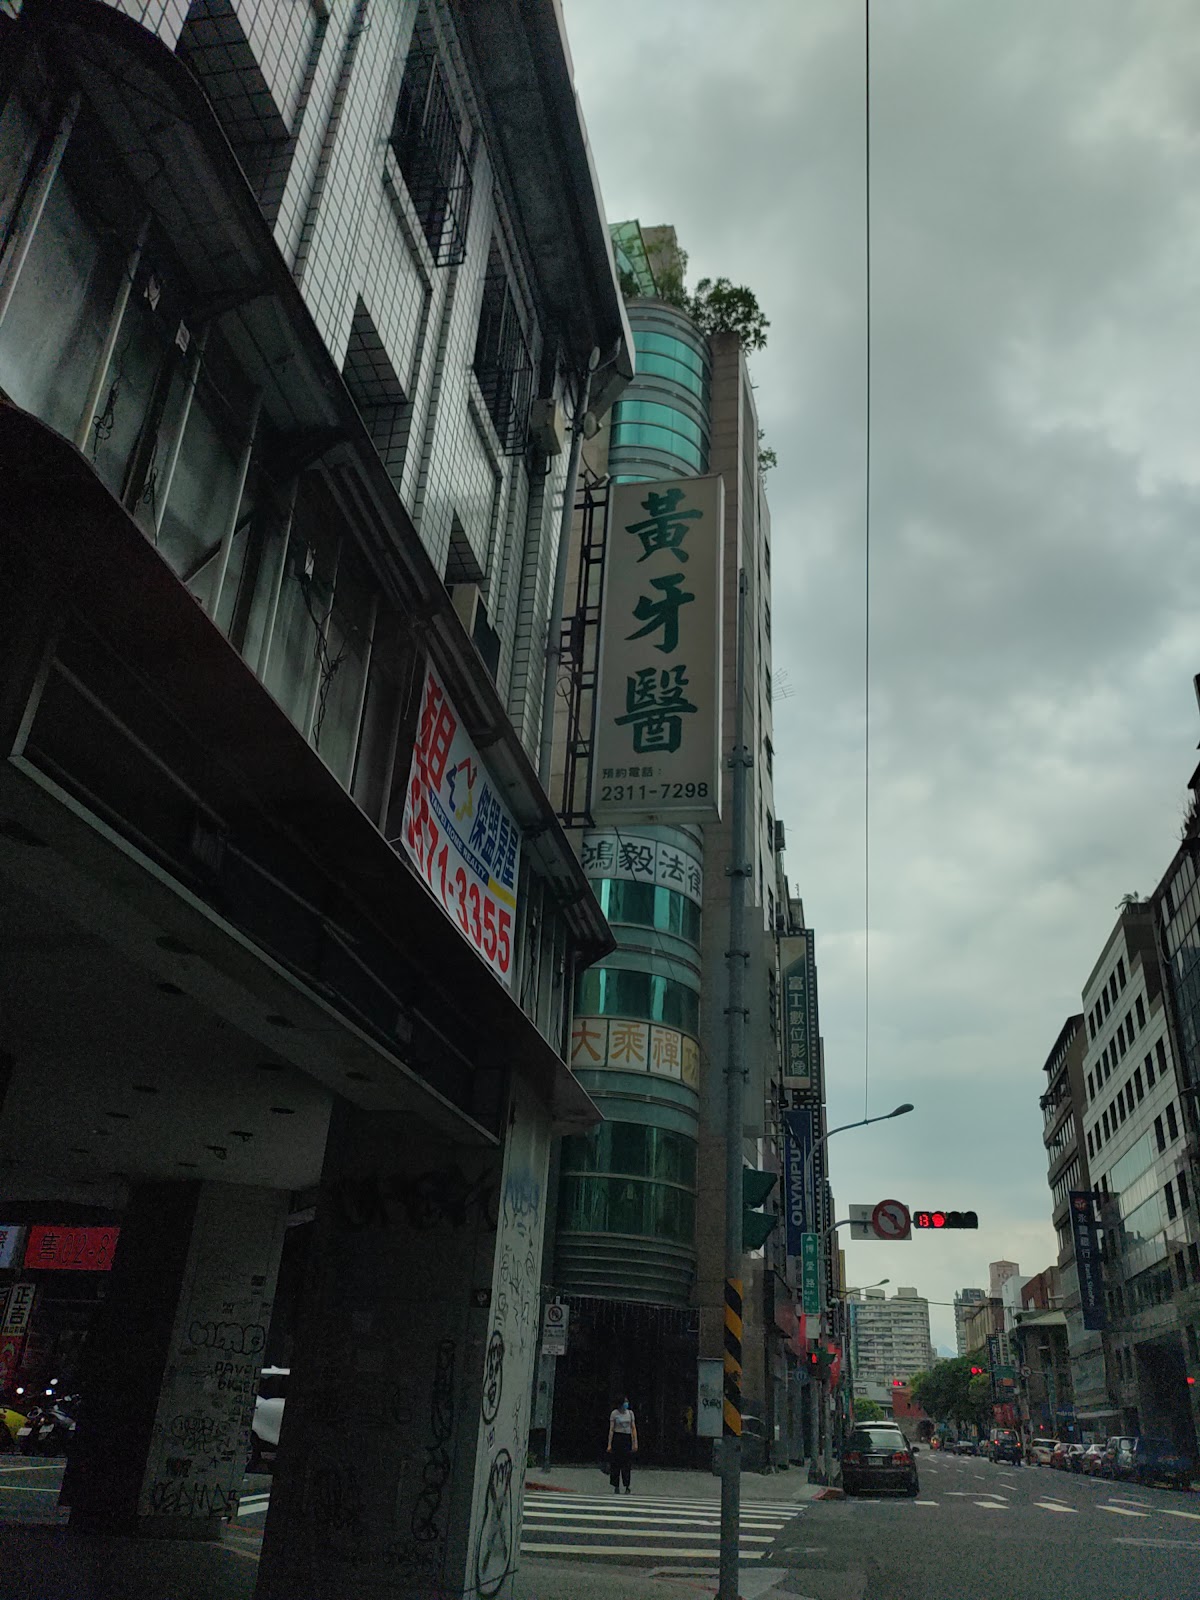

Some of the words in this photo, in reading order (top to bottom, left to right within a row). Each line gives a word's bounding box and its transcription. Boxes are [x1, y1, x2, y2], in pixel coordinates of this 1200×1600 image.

[614, 488, 703, 753] 黃牙醫
[431, 793, 446, 827] TAIPEI
[447, 824, 463, 853] HOME
[463, 850, 487, 880] REALTY
[601, 782, 708, 801] 2311-7298
[788, 976, 806, 1075] 富士數位影像
